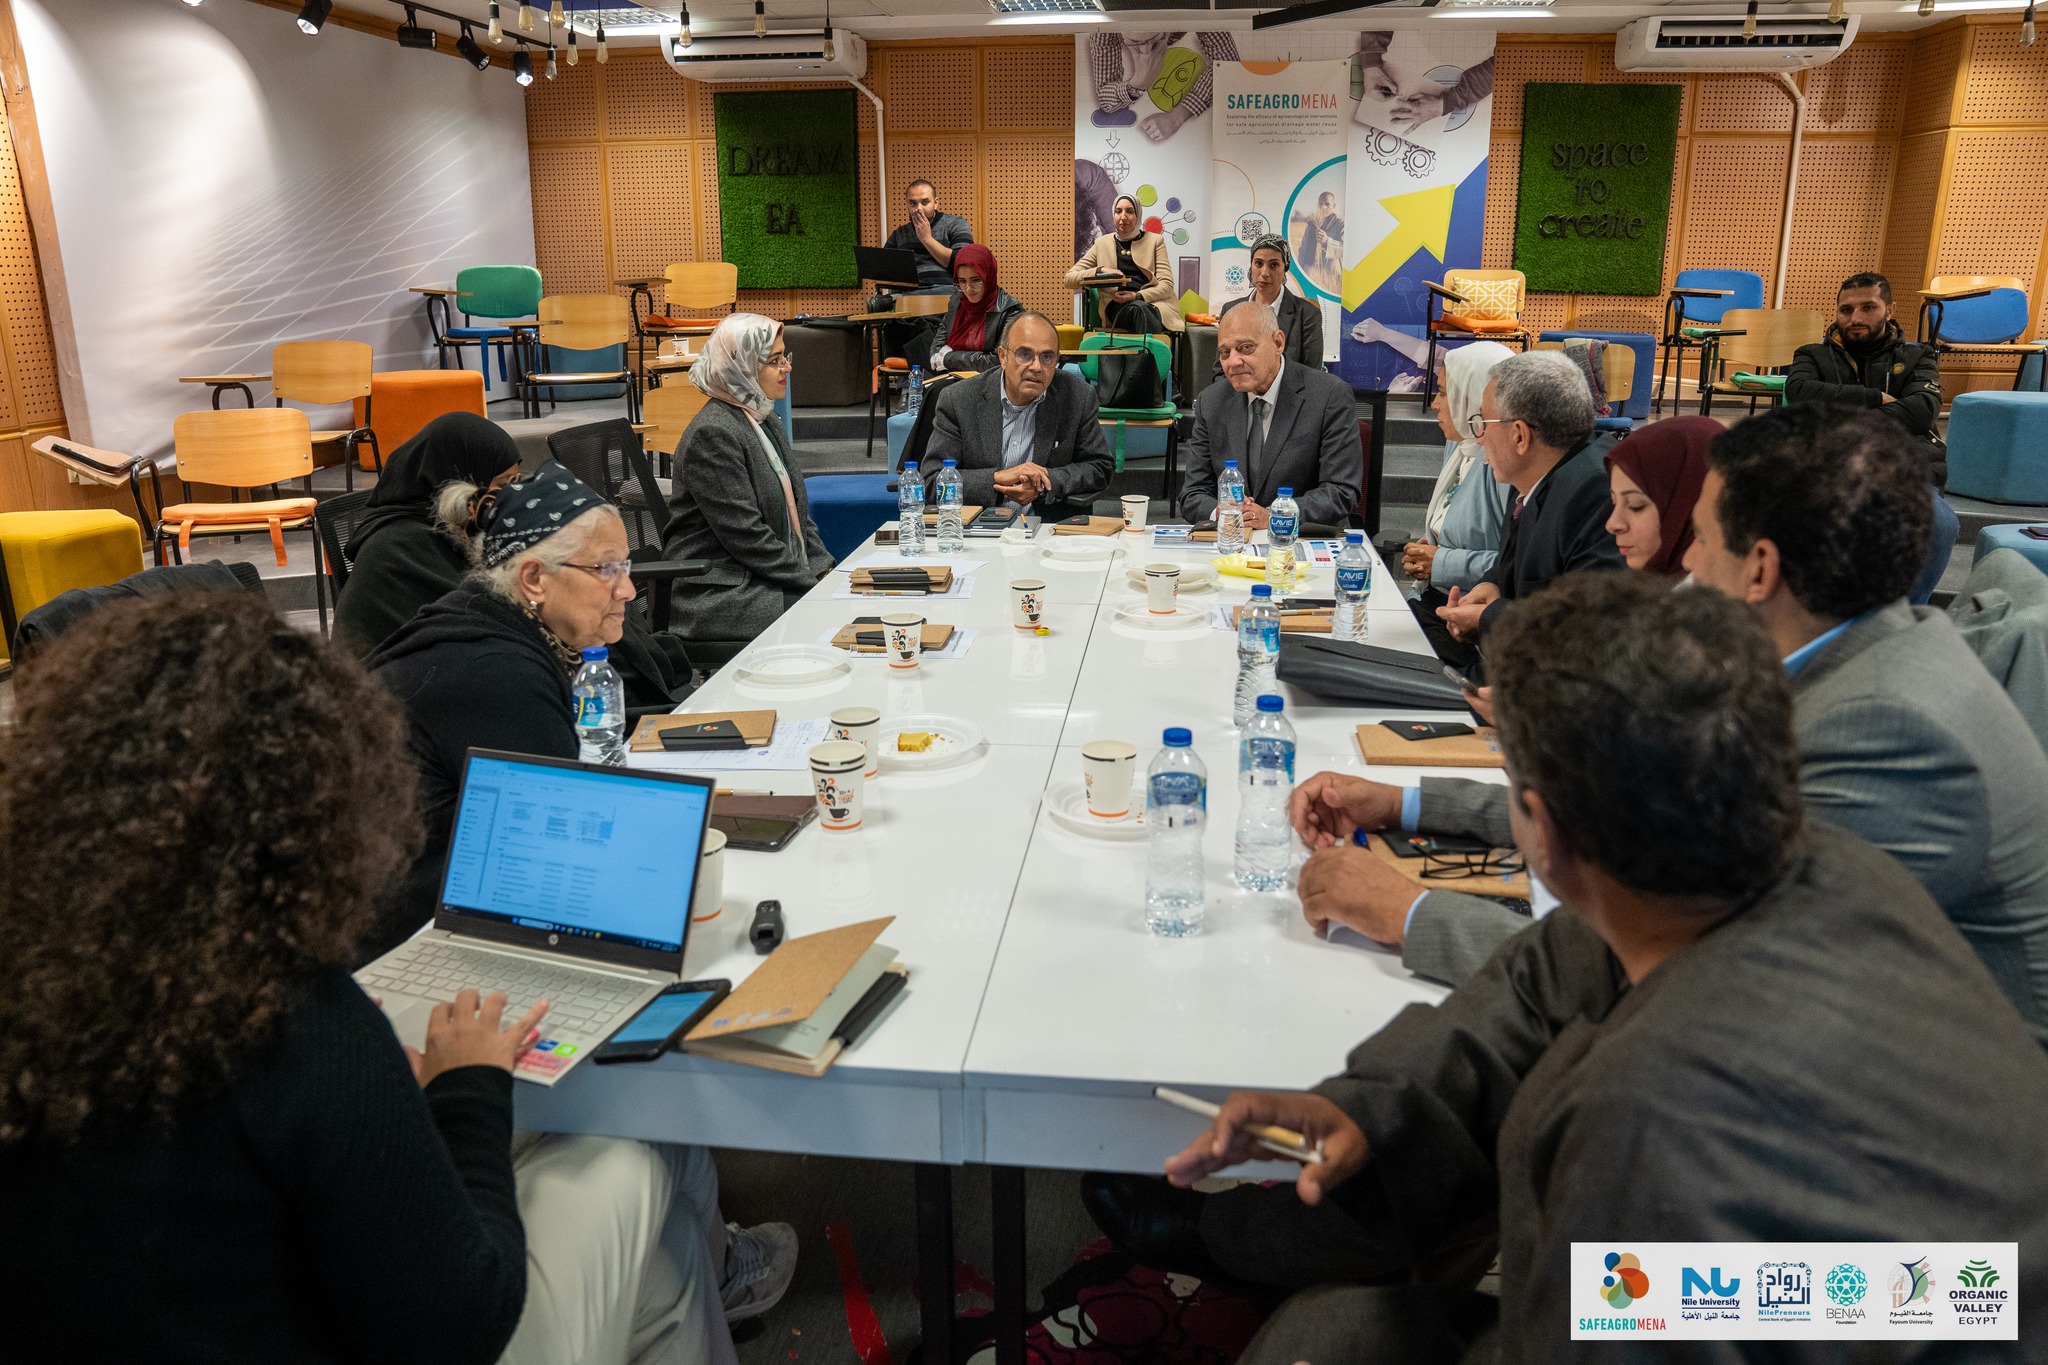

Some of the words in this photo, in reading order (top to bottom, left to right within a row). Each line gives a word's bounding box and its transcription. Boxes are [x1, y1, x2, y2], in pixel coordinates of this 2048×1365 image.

[1227, 94, 1337, 109] SAFEAGROMENA
[727, 143, 847, 177] DREAM
[1552, 141, 1650, 179] space
[1576, 176, 1610, 206] to
[766, 202, 805, 235] EA
[1538, 209, 1645, 239] create
[1271, 518, 1293, 526] LAVIE
[1338, 571, 1364, 580] LAVIE
